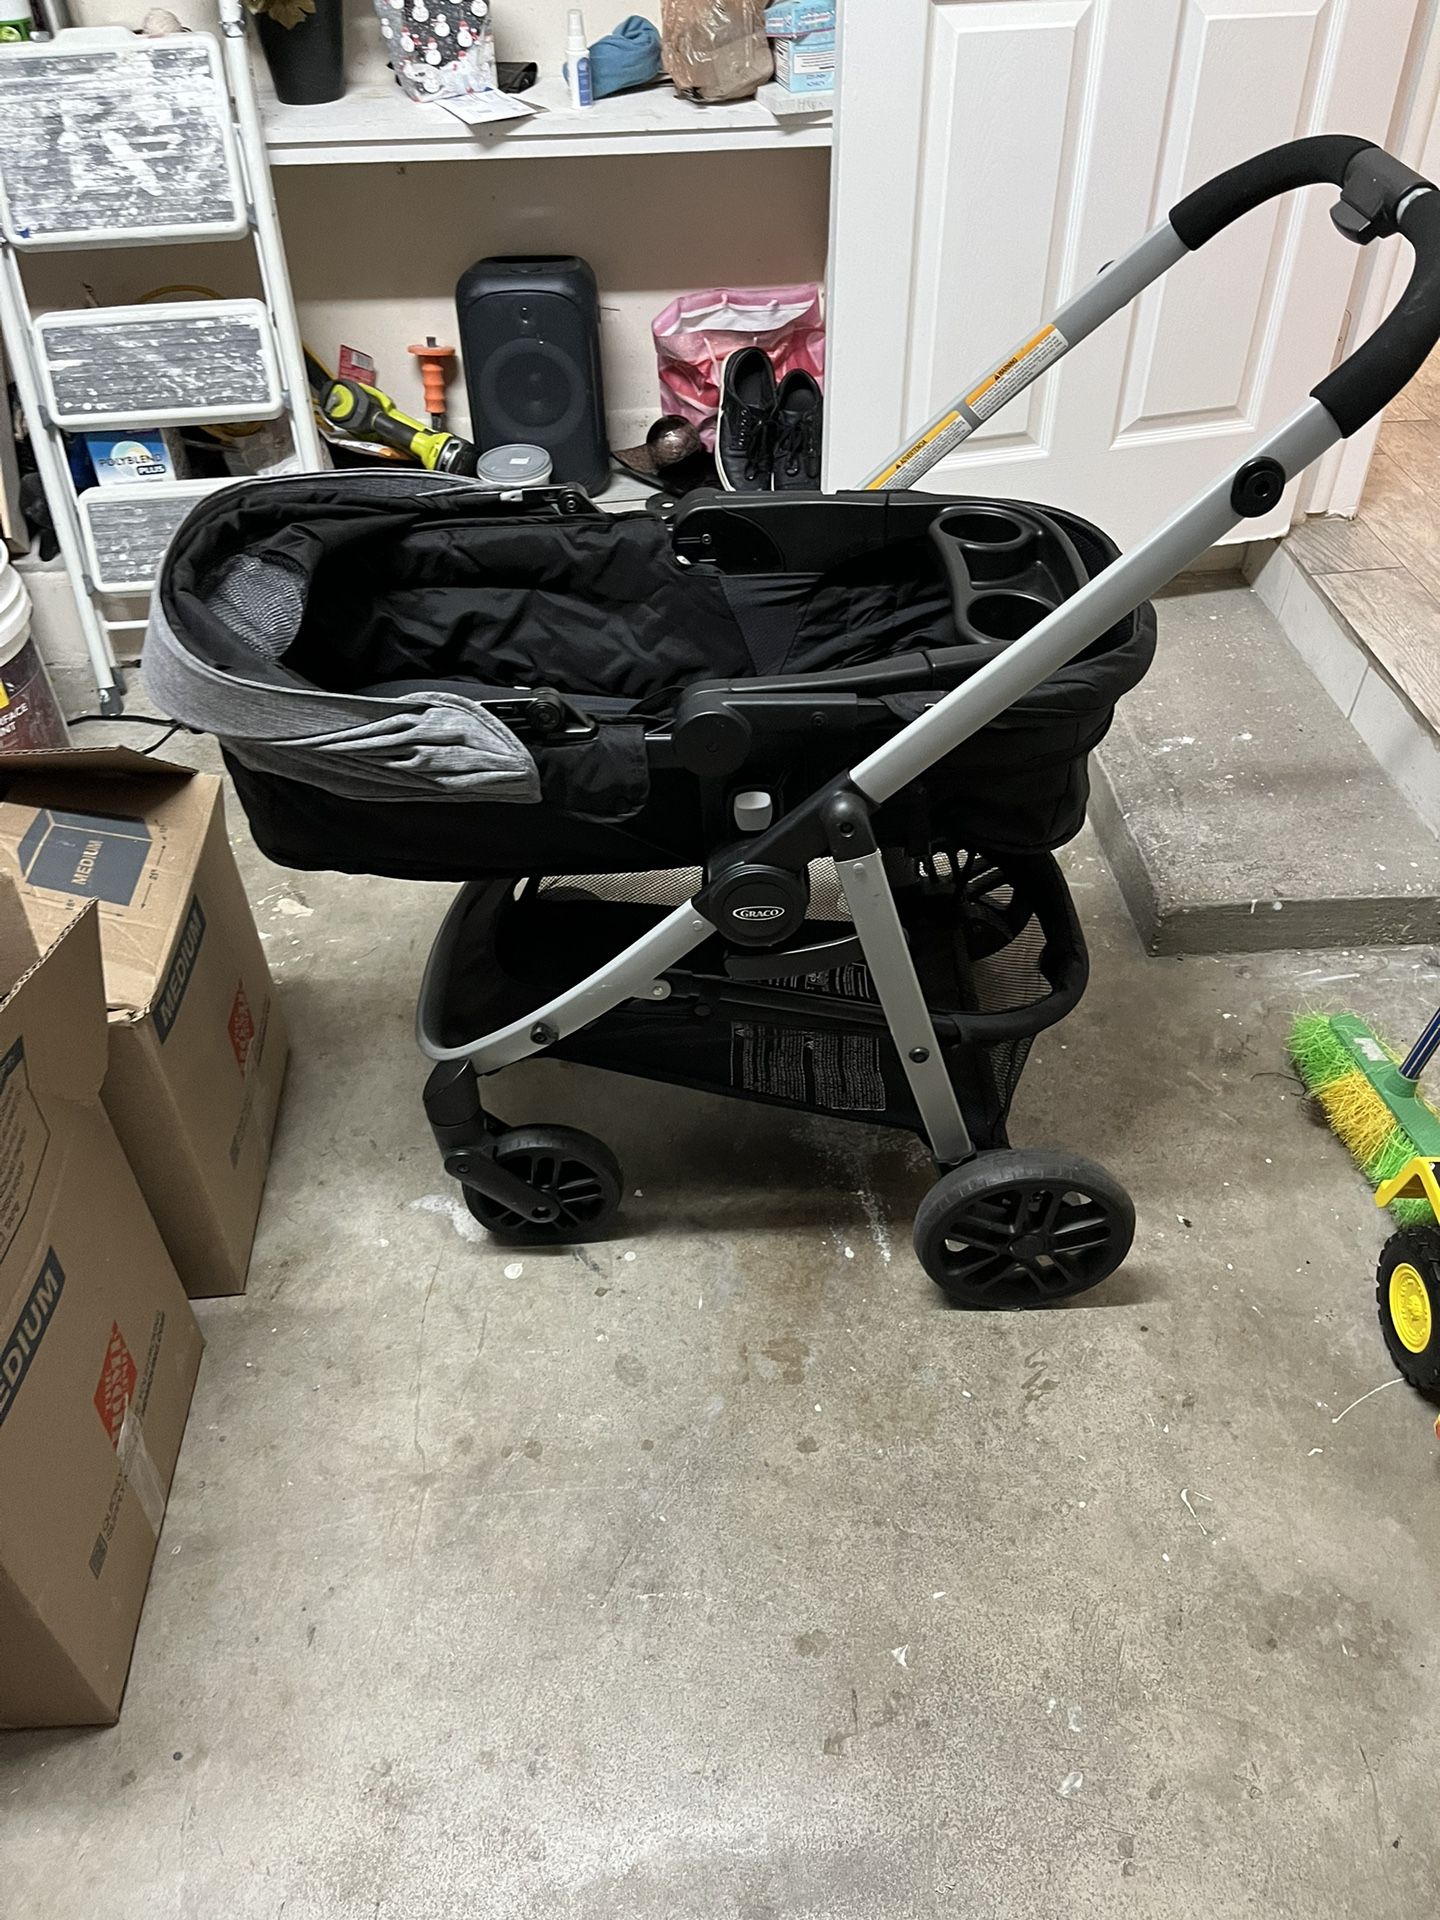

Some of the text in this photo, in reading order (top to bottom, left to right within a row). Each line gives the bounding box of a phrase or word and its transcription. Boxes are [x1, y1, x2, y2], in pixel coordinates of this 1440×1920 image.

[99, 454, 161, 466] POLYBLEND
[138, 466, 165, 474] PLUS
[71, 840, 104, 885] MEDIUM
[740, 909, 779, 918] GRACO
[160, 908, 202, 1027] MEDIUM
